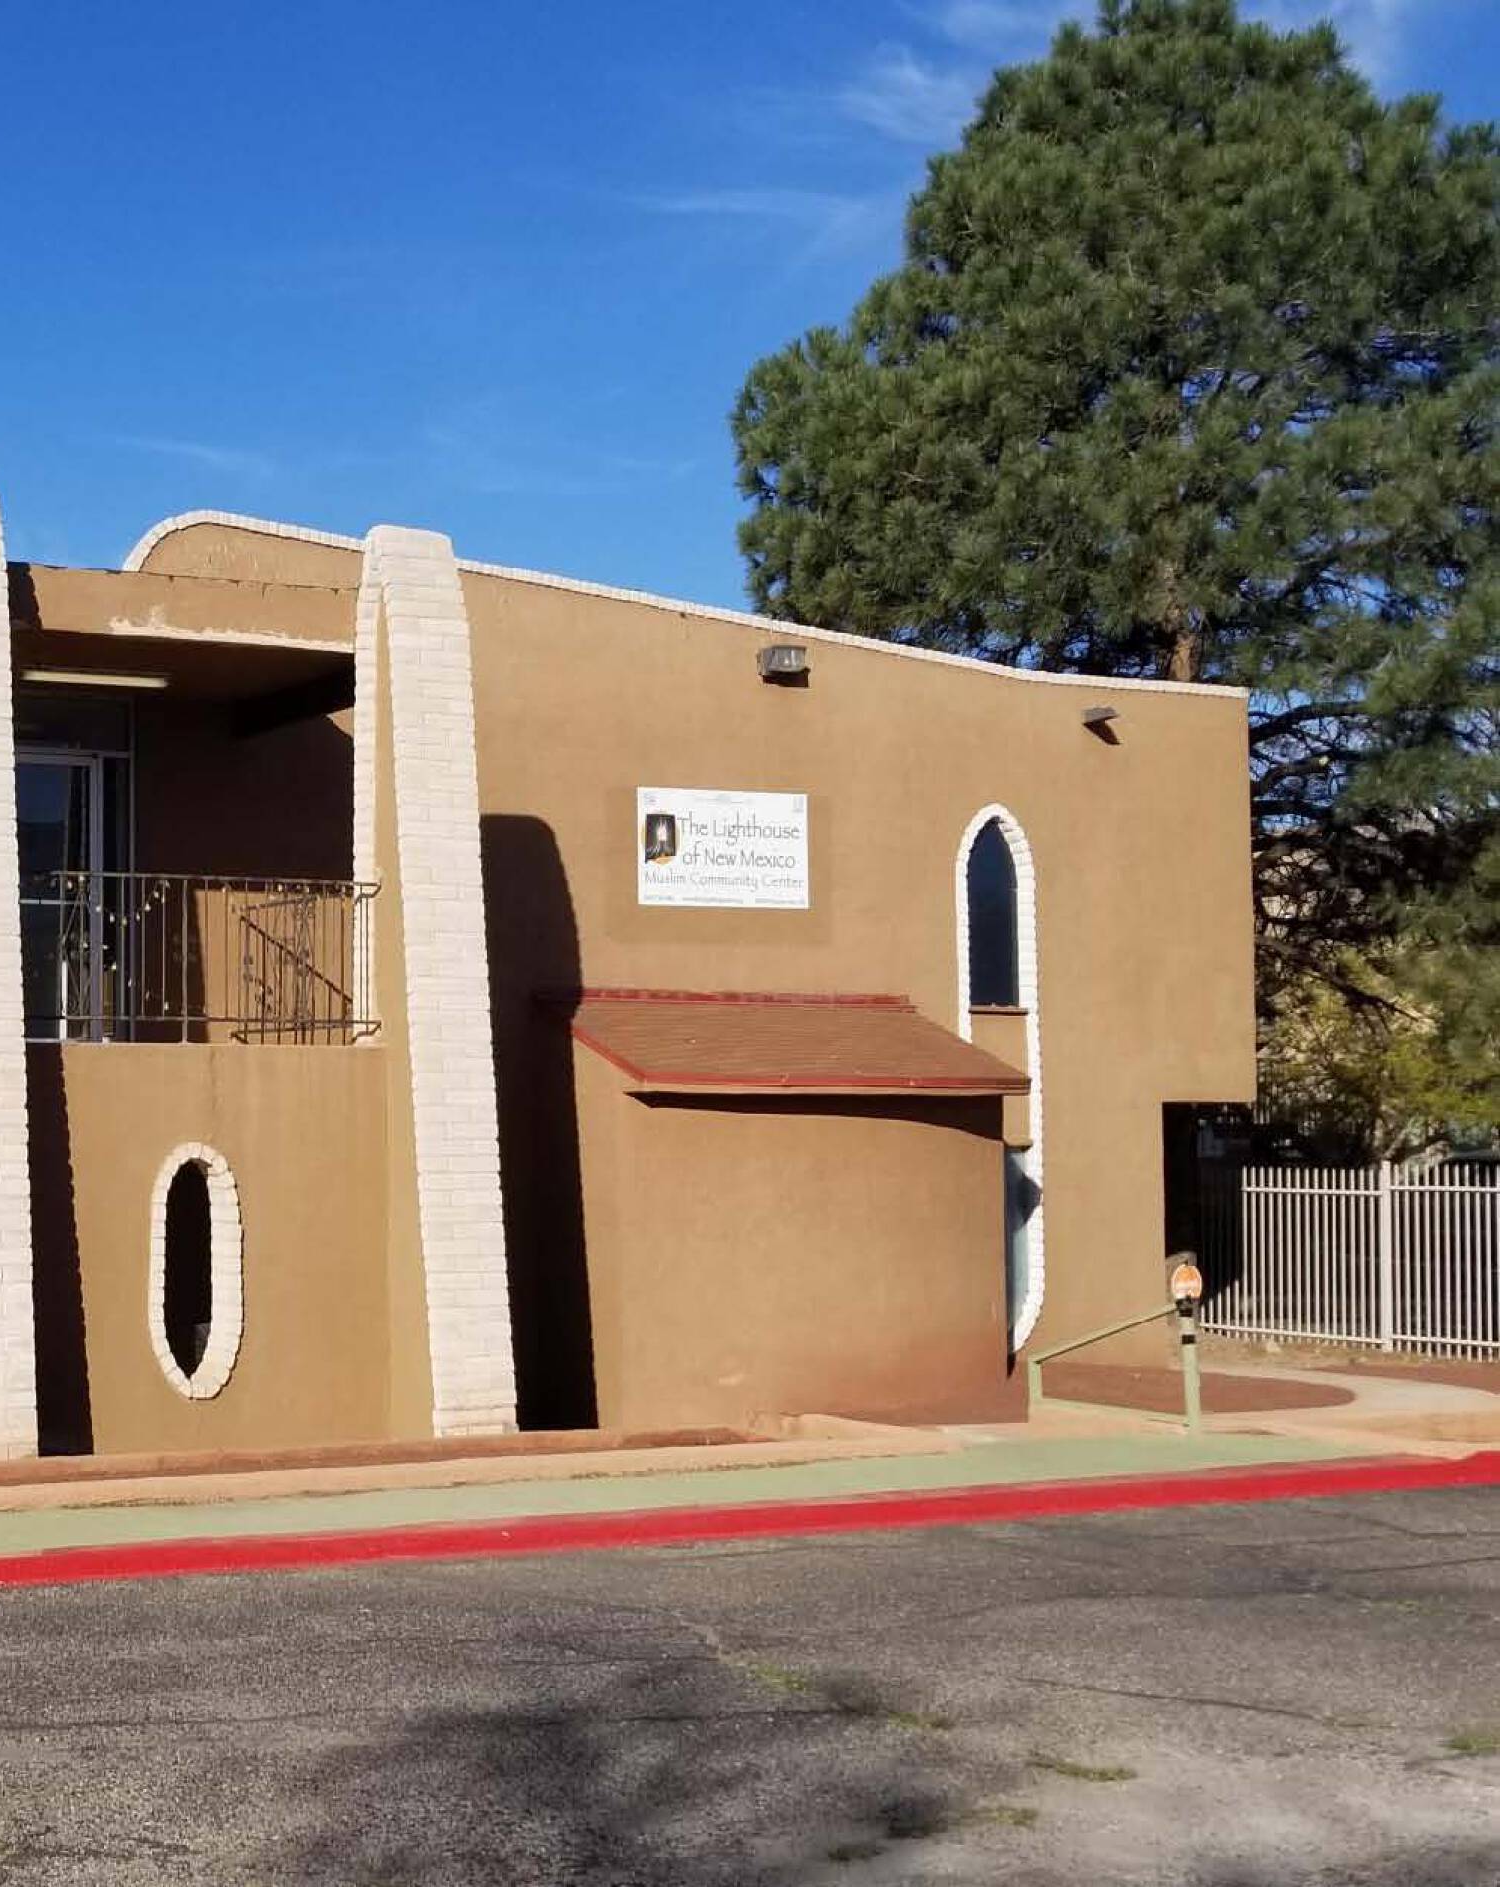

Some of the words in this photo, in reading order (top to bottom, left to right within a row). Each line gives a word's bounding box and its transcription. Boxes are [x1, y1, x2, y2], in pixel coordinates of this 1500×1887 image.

[677, 811, 708, 836] The
[713, 810, 800, 846] Lighthouse
[682, 841, 702, 865] of
[705, 848, 737, 866] New
[741, 850, 796, 869] Mexico
[645, 869, 686, 885] Muslim
[690, 871, 758, 892] Community
[762, 873, 804, 889] Center
